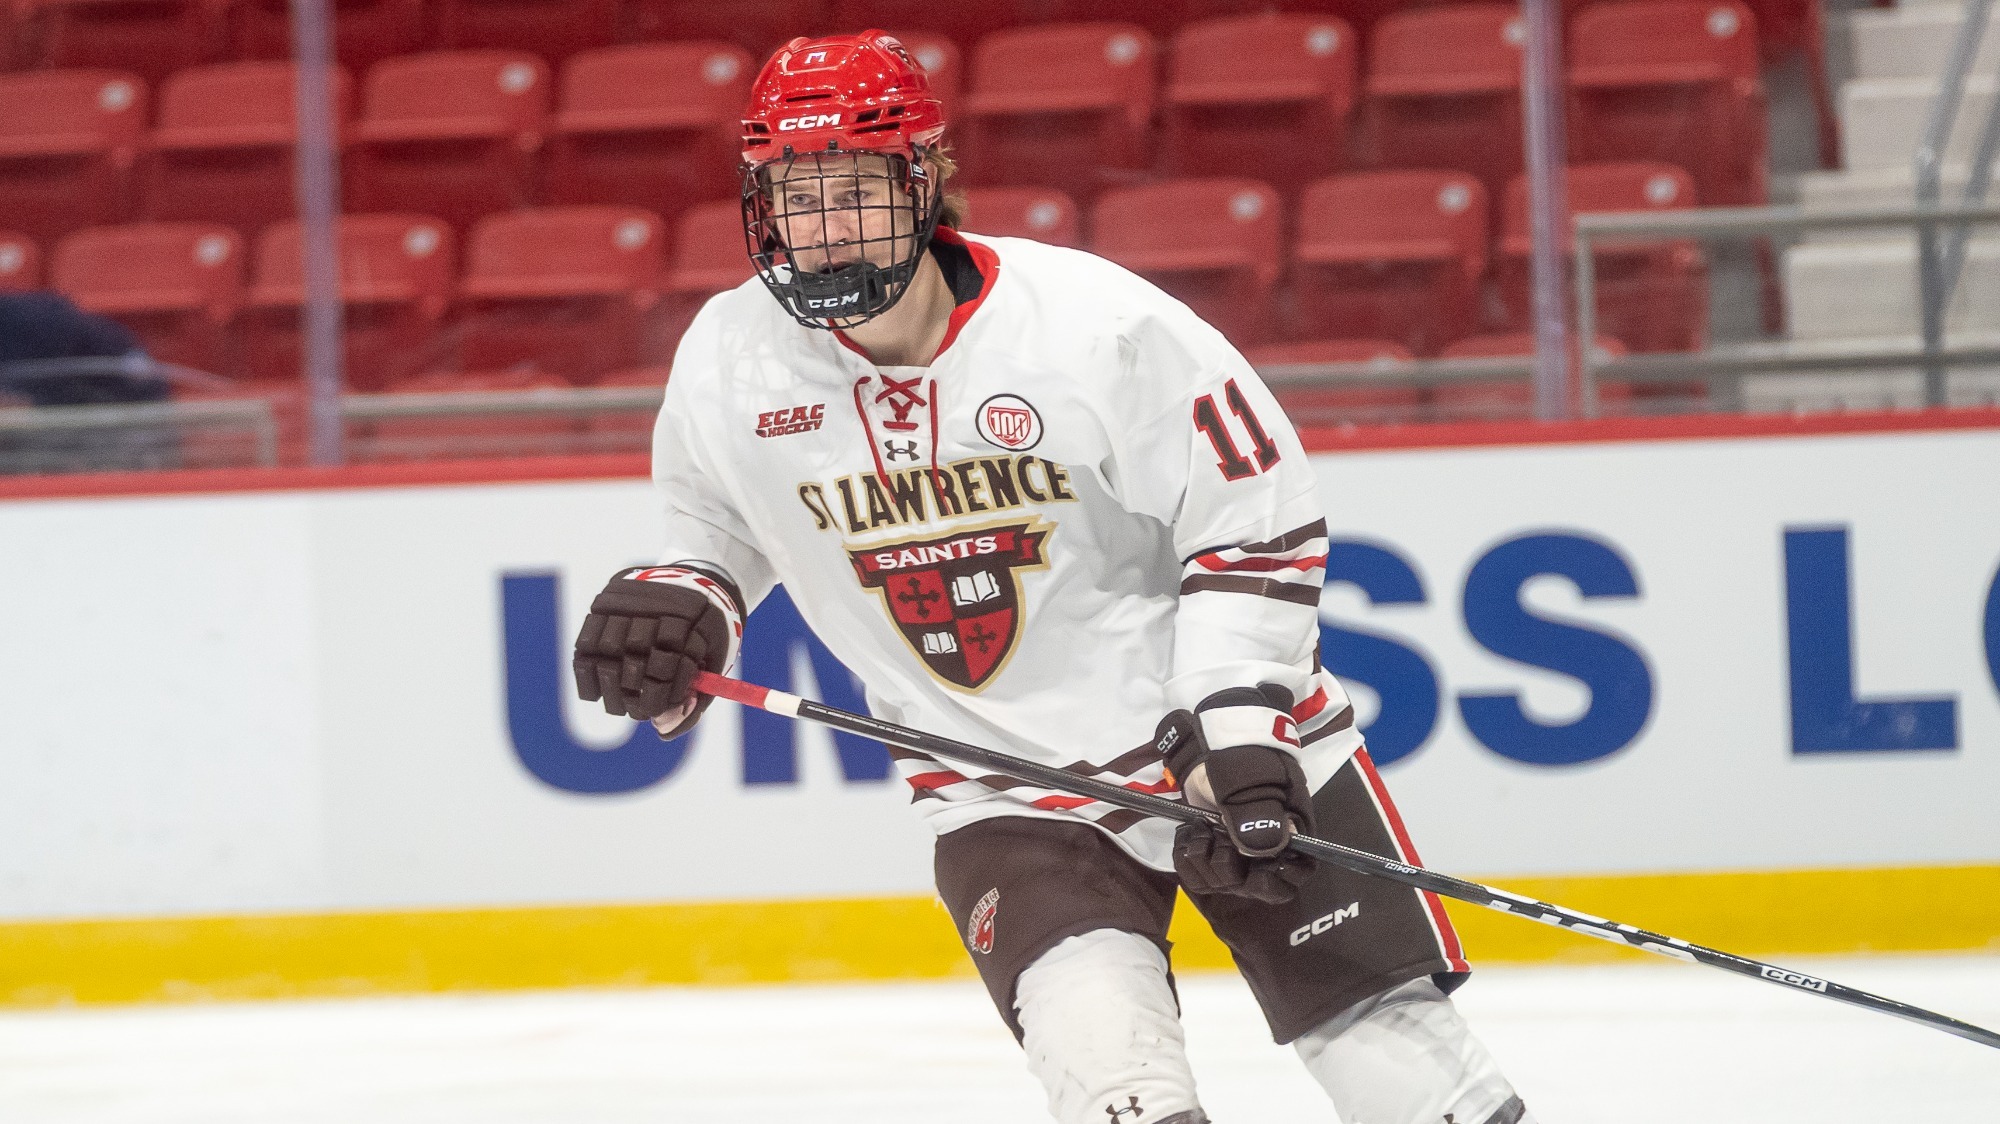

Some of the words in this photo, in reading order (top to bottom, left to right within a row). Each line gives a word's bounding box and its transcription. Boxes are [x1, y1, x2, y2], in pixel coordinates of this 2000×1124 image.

[779, 113, 841, 131] CCM
[808, 291, 860, 310] CCM
[758, 403, 825, 429] ECAC
[767, 419, 822, 438] HOCKEY
[1192, 377, 1281, 482] 11
[834, 454, 1078, 536] LAWRENCE
[875, 536, 998, 570] SAINTS
[1783, 523, 2000, 756] L
[1157, 726, 1177, 752] CCM
[1240, 819, 1281, 832] CCM
[1290, 902, 1360, 947] CCM
[1765, 969, 1822, 989] CCM
